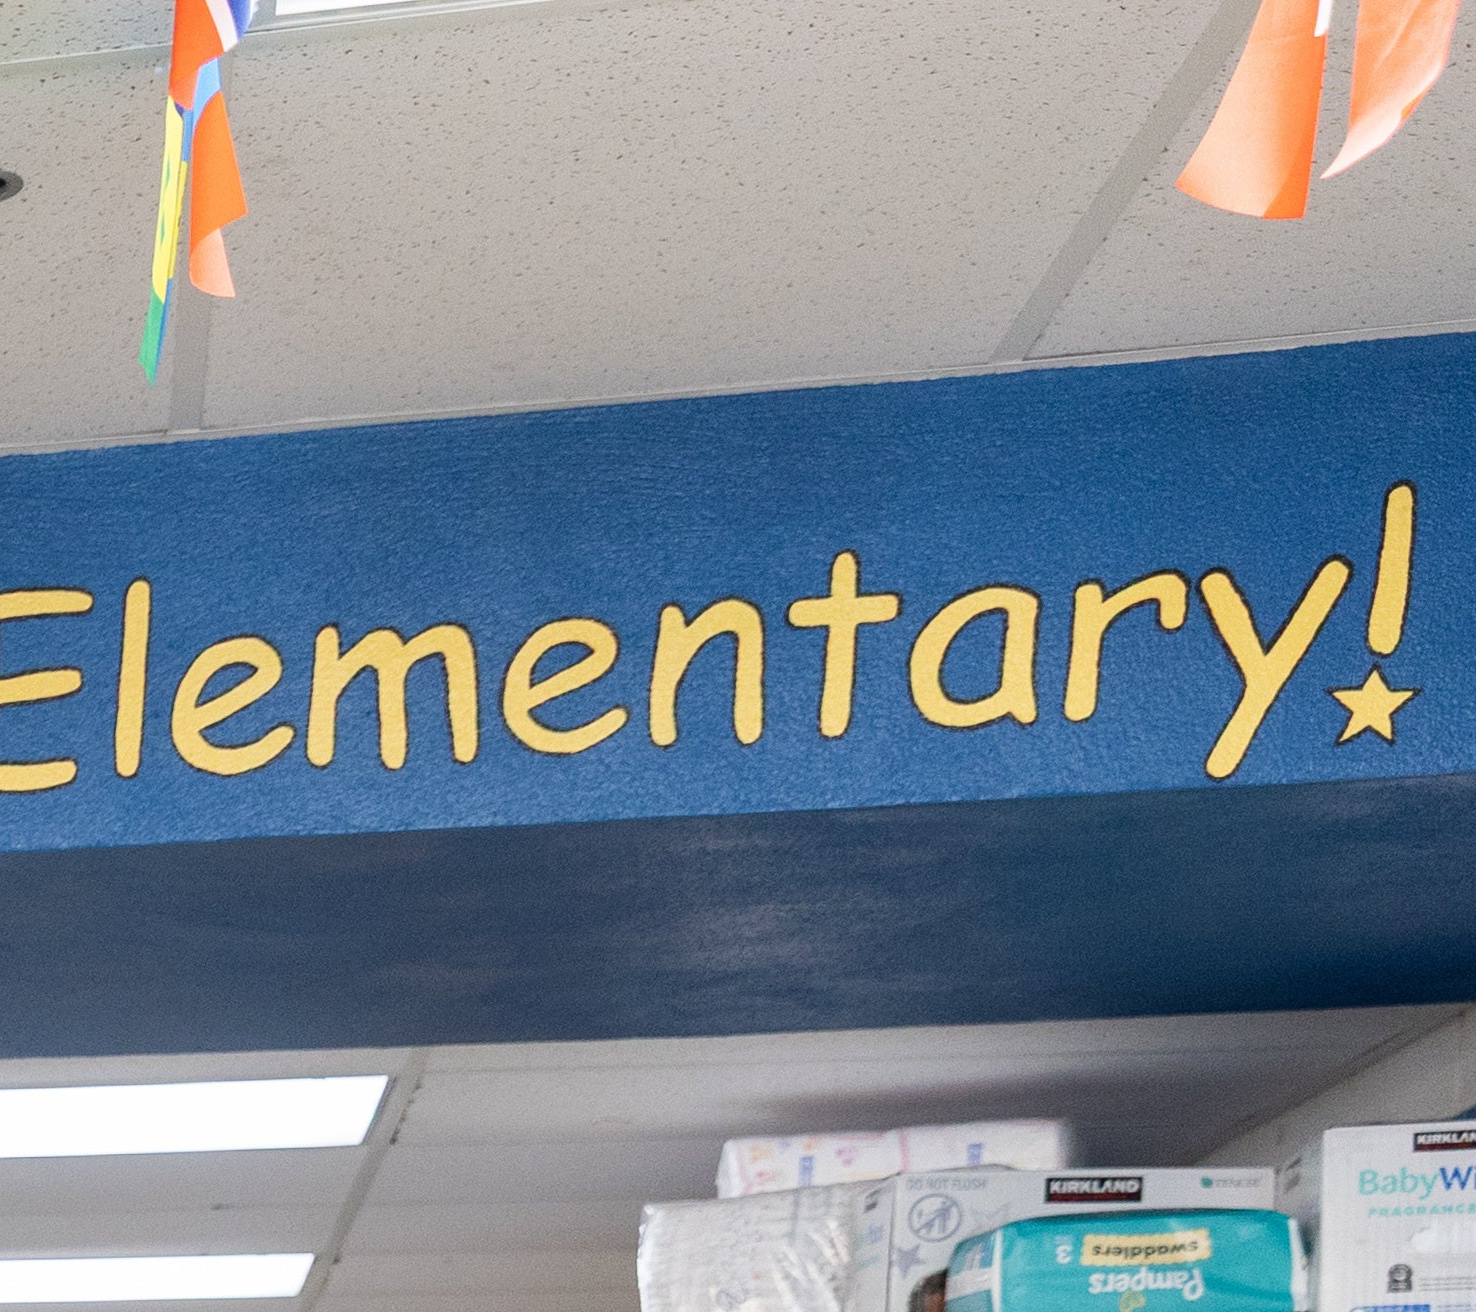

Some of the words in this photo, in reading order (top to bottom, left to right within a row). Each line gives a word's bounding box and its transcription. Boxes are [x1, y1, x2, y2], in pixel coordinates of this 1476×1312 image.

[1046, 1177, 1141, 1198] KIRKLAND
[1055, 1244, 1073, 1264] 3
[1091, 1241, 1199, 1260] swaddlers
[1088, 1267, 1205, 1302] Pampers
